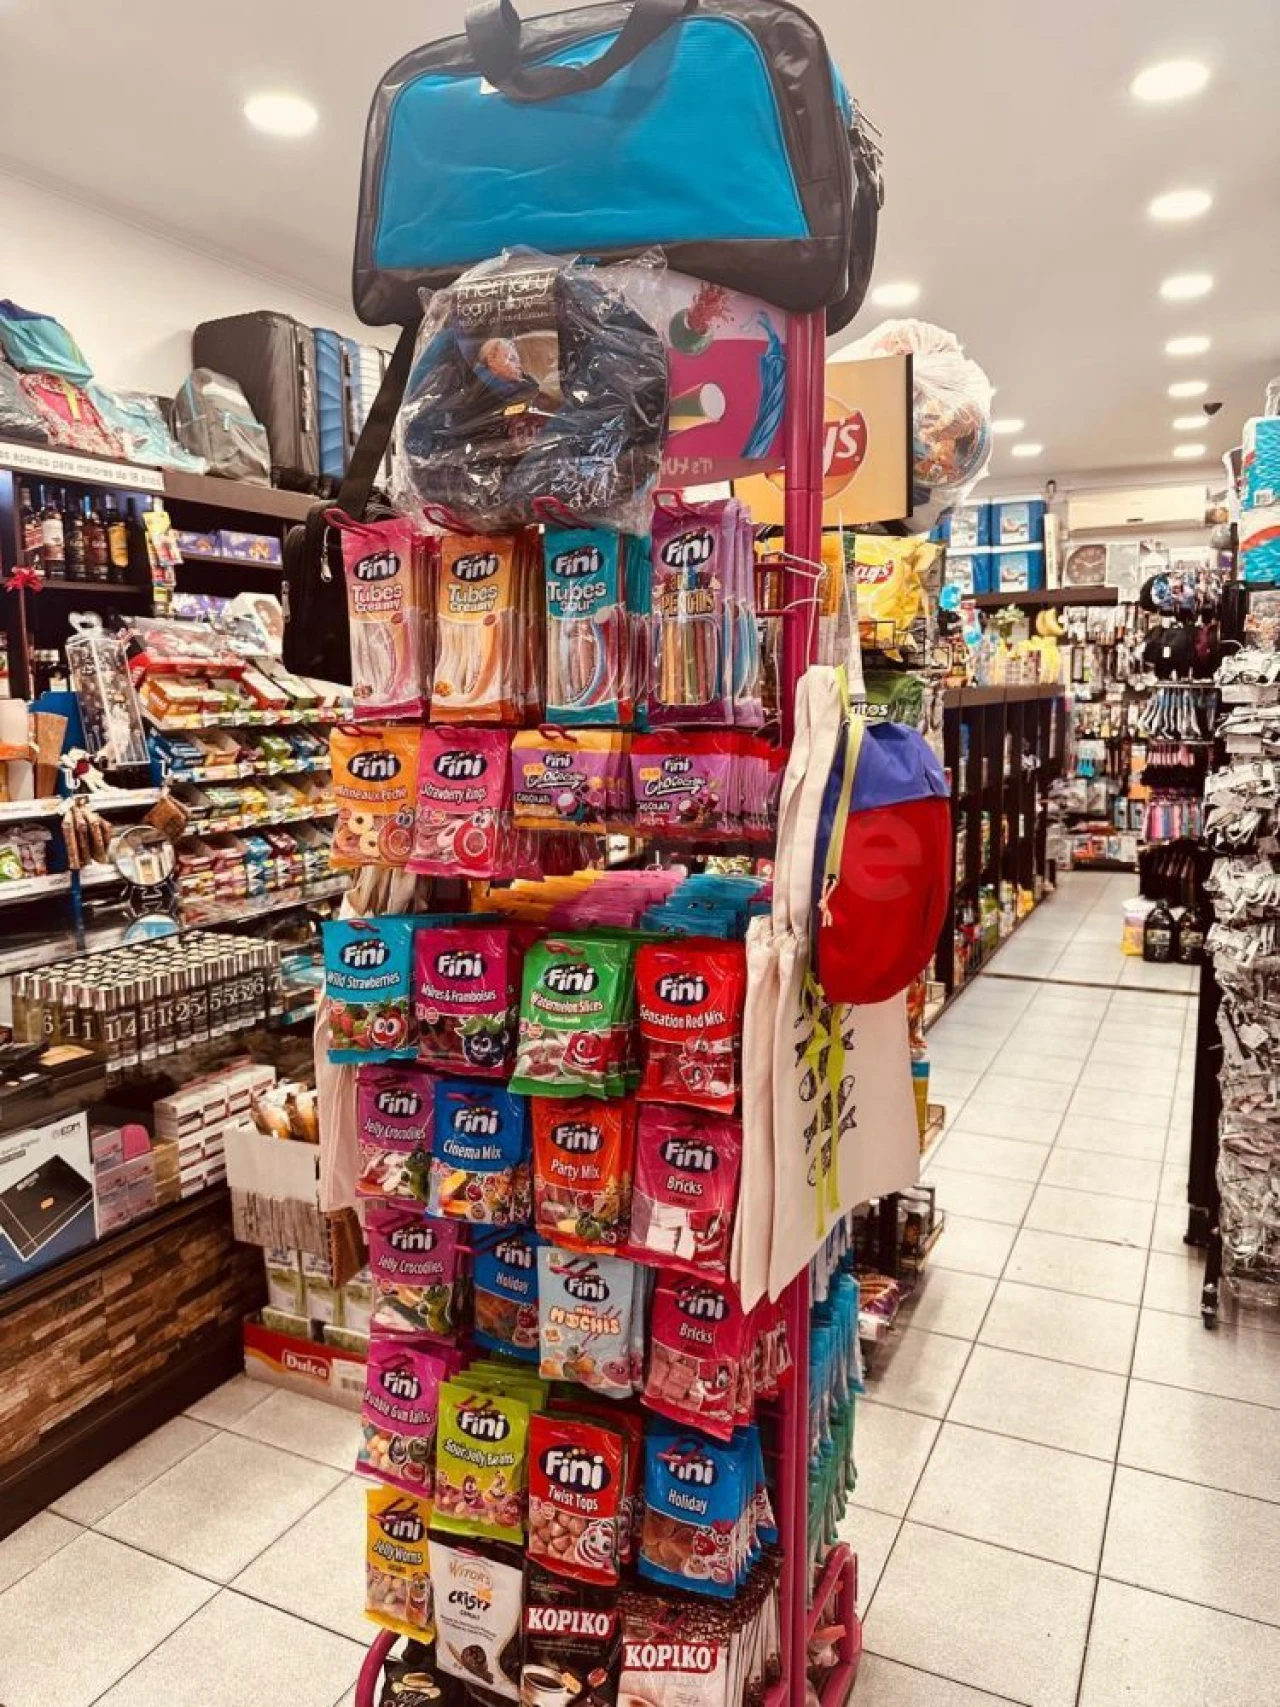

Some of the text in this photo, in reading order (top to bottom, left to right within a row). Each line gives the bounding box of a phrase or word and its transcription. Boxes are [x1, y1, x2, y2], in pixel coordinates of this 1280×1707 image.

[664, 528, 711, 567] Fini
[357, 553, 397, 580] Fini
[454, 553, 497, 579] Fini
[555, 547, 599, 576] Fini
[351, 584, 403, 602] Tubes
[448, 583, 499, 602] Tubes
[546, 581, 607, 602] Tubes
[351, 752, 396, 778] Fini
[436, 753, 483, 777] Fini
[343, 941, 386, 967] Fini
[437, 951, 483, 978] Fini
[347, 971, 401, 990] Strawberries
[547, 966, 595, 993] Fini
[659, 974, 705, 1003] Fini
[640, 1003, 726, 1029] Sensation Red Mix
[378, 1090, 419, 1116] Fini
[454, 1108, 499, 1135] Fini
[443, 1140, 502, 1160] Cinema Mix
[554, 1124, 600, 1151] Fini
[664, 1140, 714, 1171] Fini
[551, 1158, 600, 1181] Party Mix
[666, 1175, 703, 1196] Bricks
[391, 1228, 434, 1251] Fini
[495, 1242, 533, 1269] Fini
[495, 1271, 529, 1294] Holiday
[568, 1277, 606, 1301] Fini
[678, 1322, 714, 1345] Bricks
[383, 1370, 419, 1399] Fini
[460, 1411, 505, 1440] Fini
[545, 1449, 605, 1491] Fini
[547, 1484, 598, 1512] Twist Tops
[667, 1488, 709, 1516] Holiday
[527, 1606, 611, 1637] KOPIKO
[624, 1644, 713, 1671] KOPIKO
